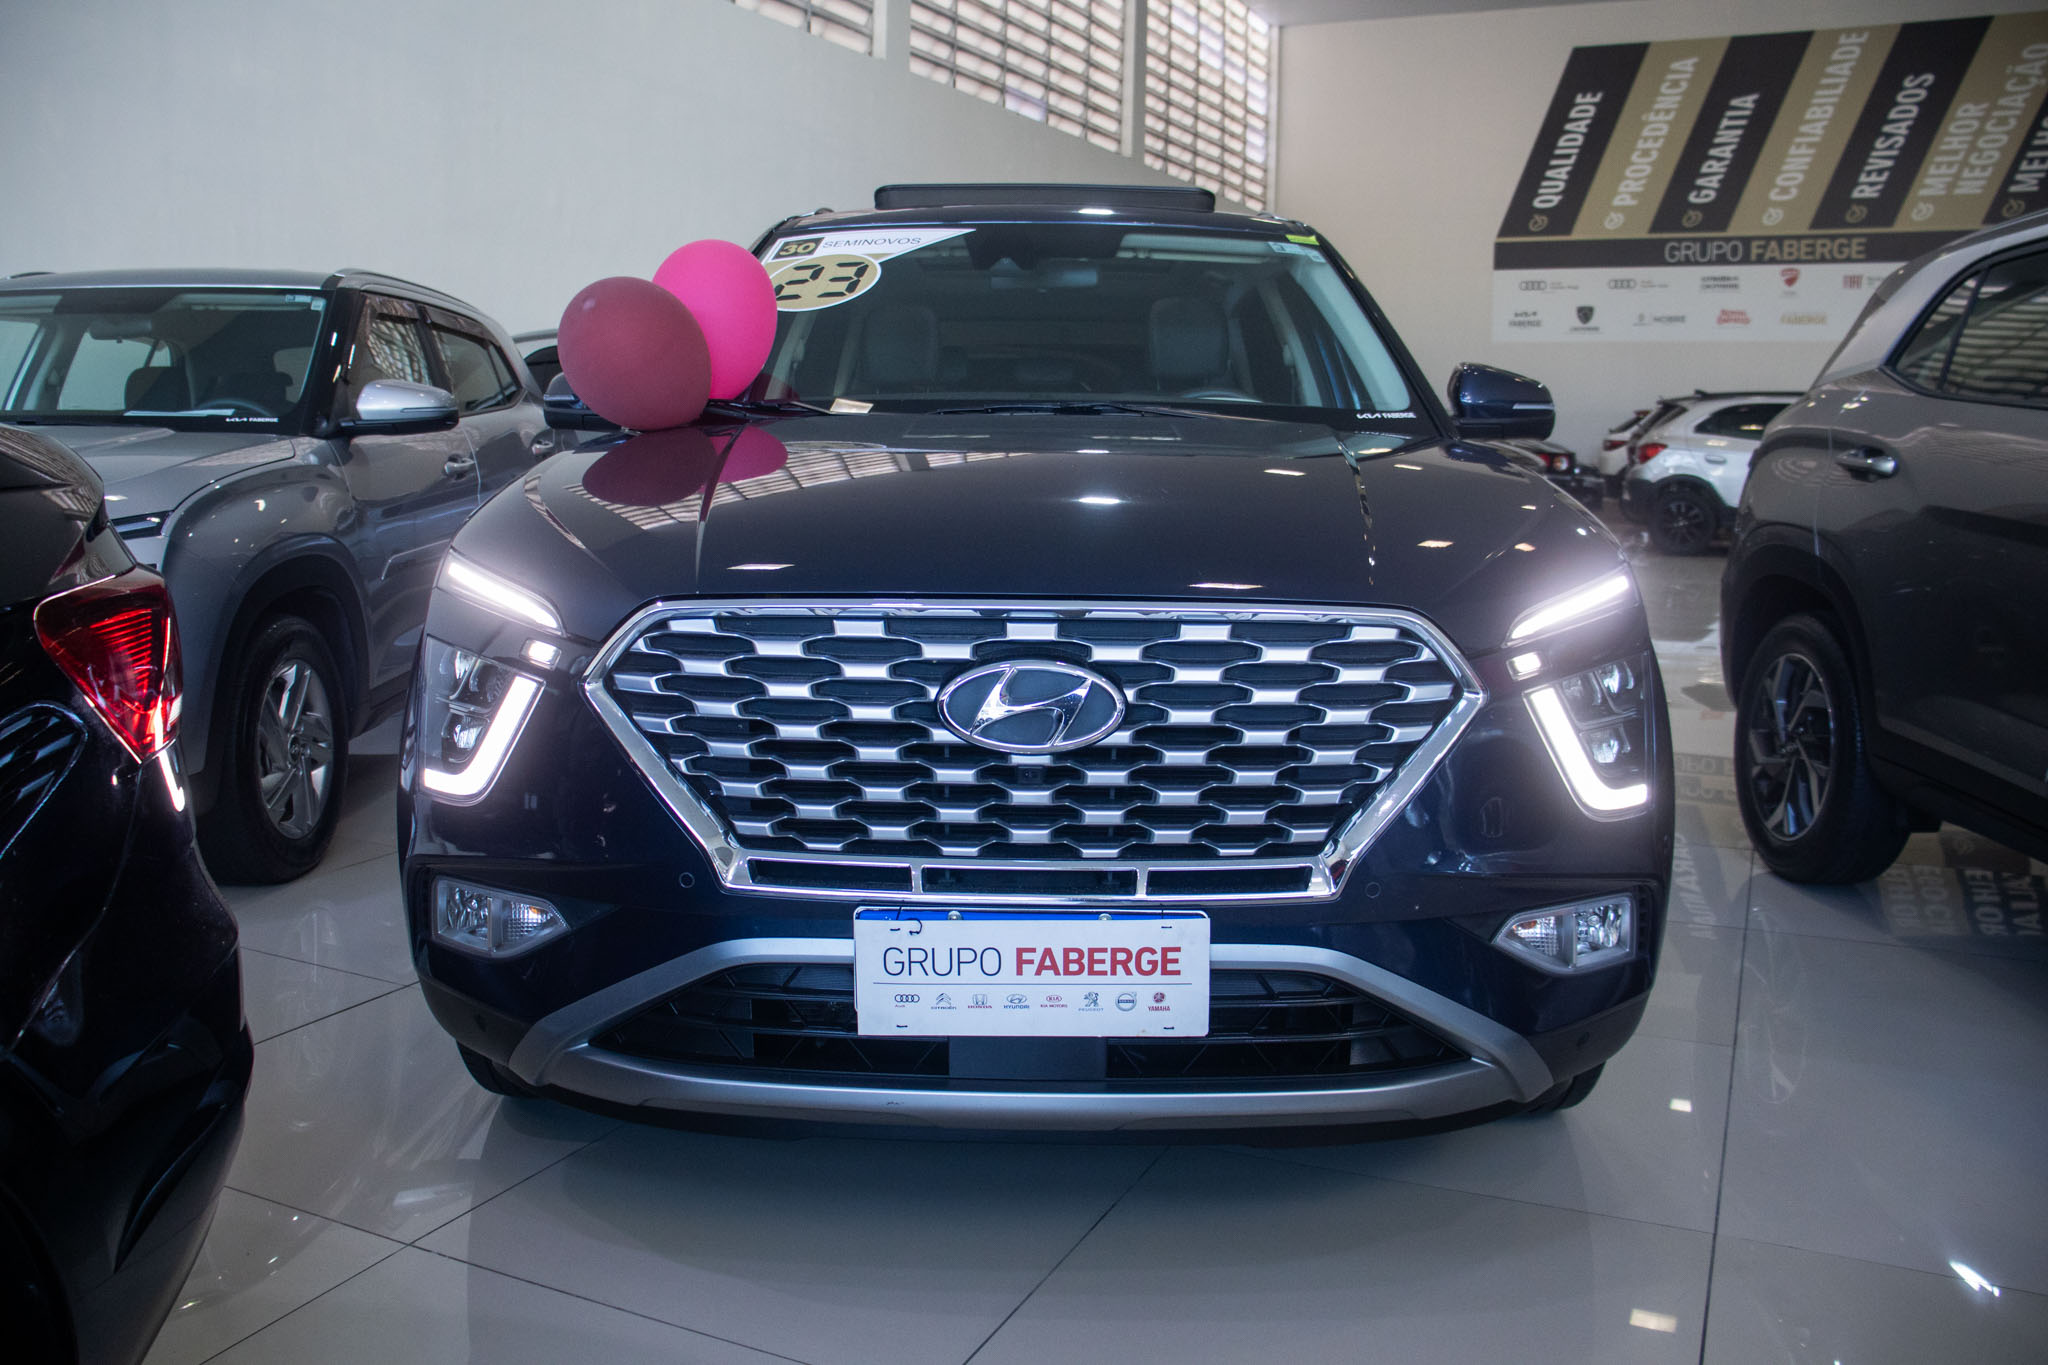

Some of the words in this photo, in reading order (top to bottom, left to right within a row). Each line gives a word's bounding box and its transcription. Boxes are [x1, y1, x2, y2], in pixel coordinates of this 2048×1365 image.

[1532, 91, 1604, 209] QUALIDADE
[1612, 57, 1699, 207] PROCEDÊNCIA
[1688, 92, 1760, 204] GARANTIA
[1851, 72, 1935, 199] REVISADOS
[1918, 102, 1990, 196] MELHOR
[775, 261, 869, 301] 23
[779, 241, 817, 256] 30
[822, 237, 921, 249] SEMINOVOS
[1664, 239, 1742, 263] GRUPO
[1751, 237, 1867, 262] FABERGE
[883, 946, 1001, 977] GRUPO
[1015, 946, 1181, 976] FABERGE
